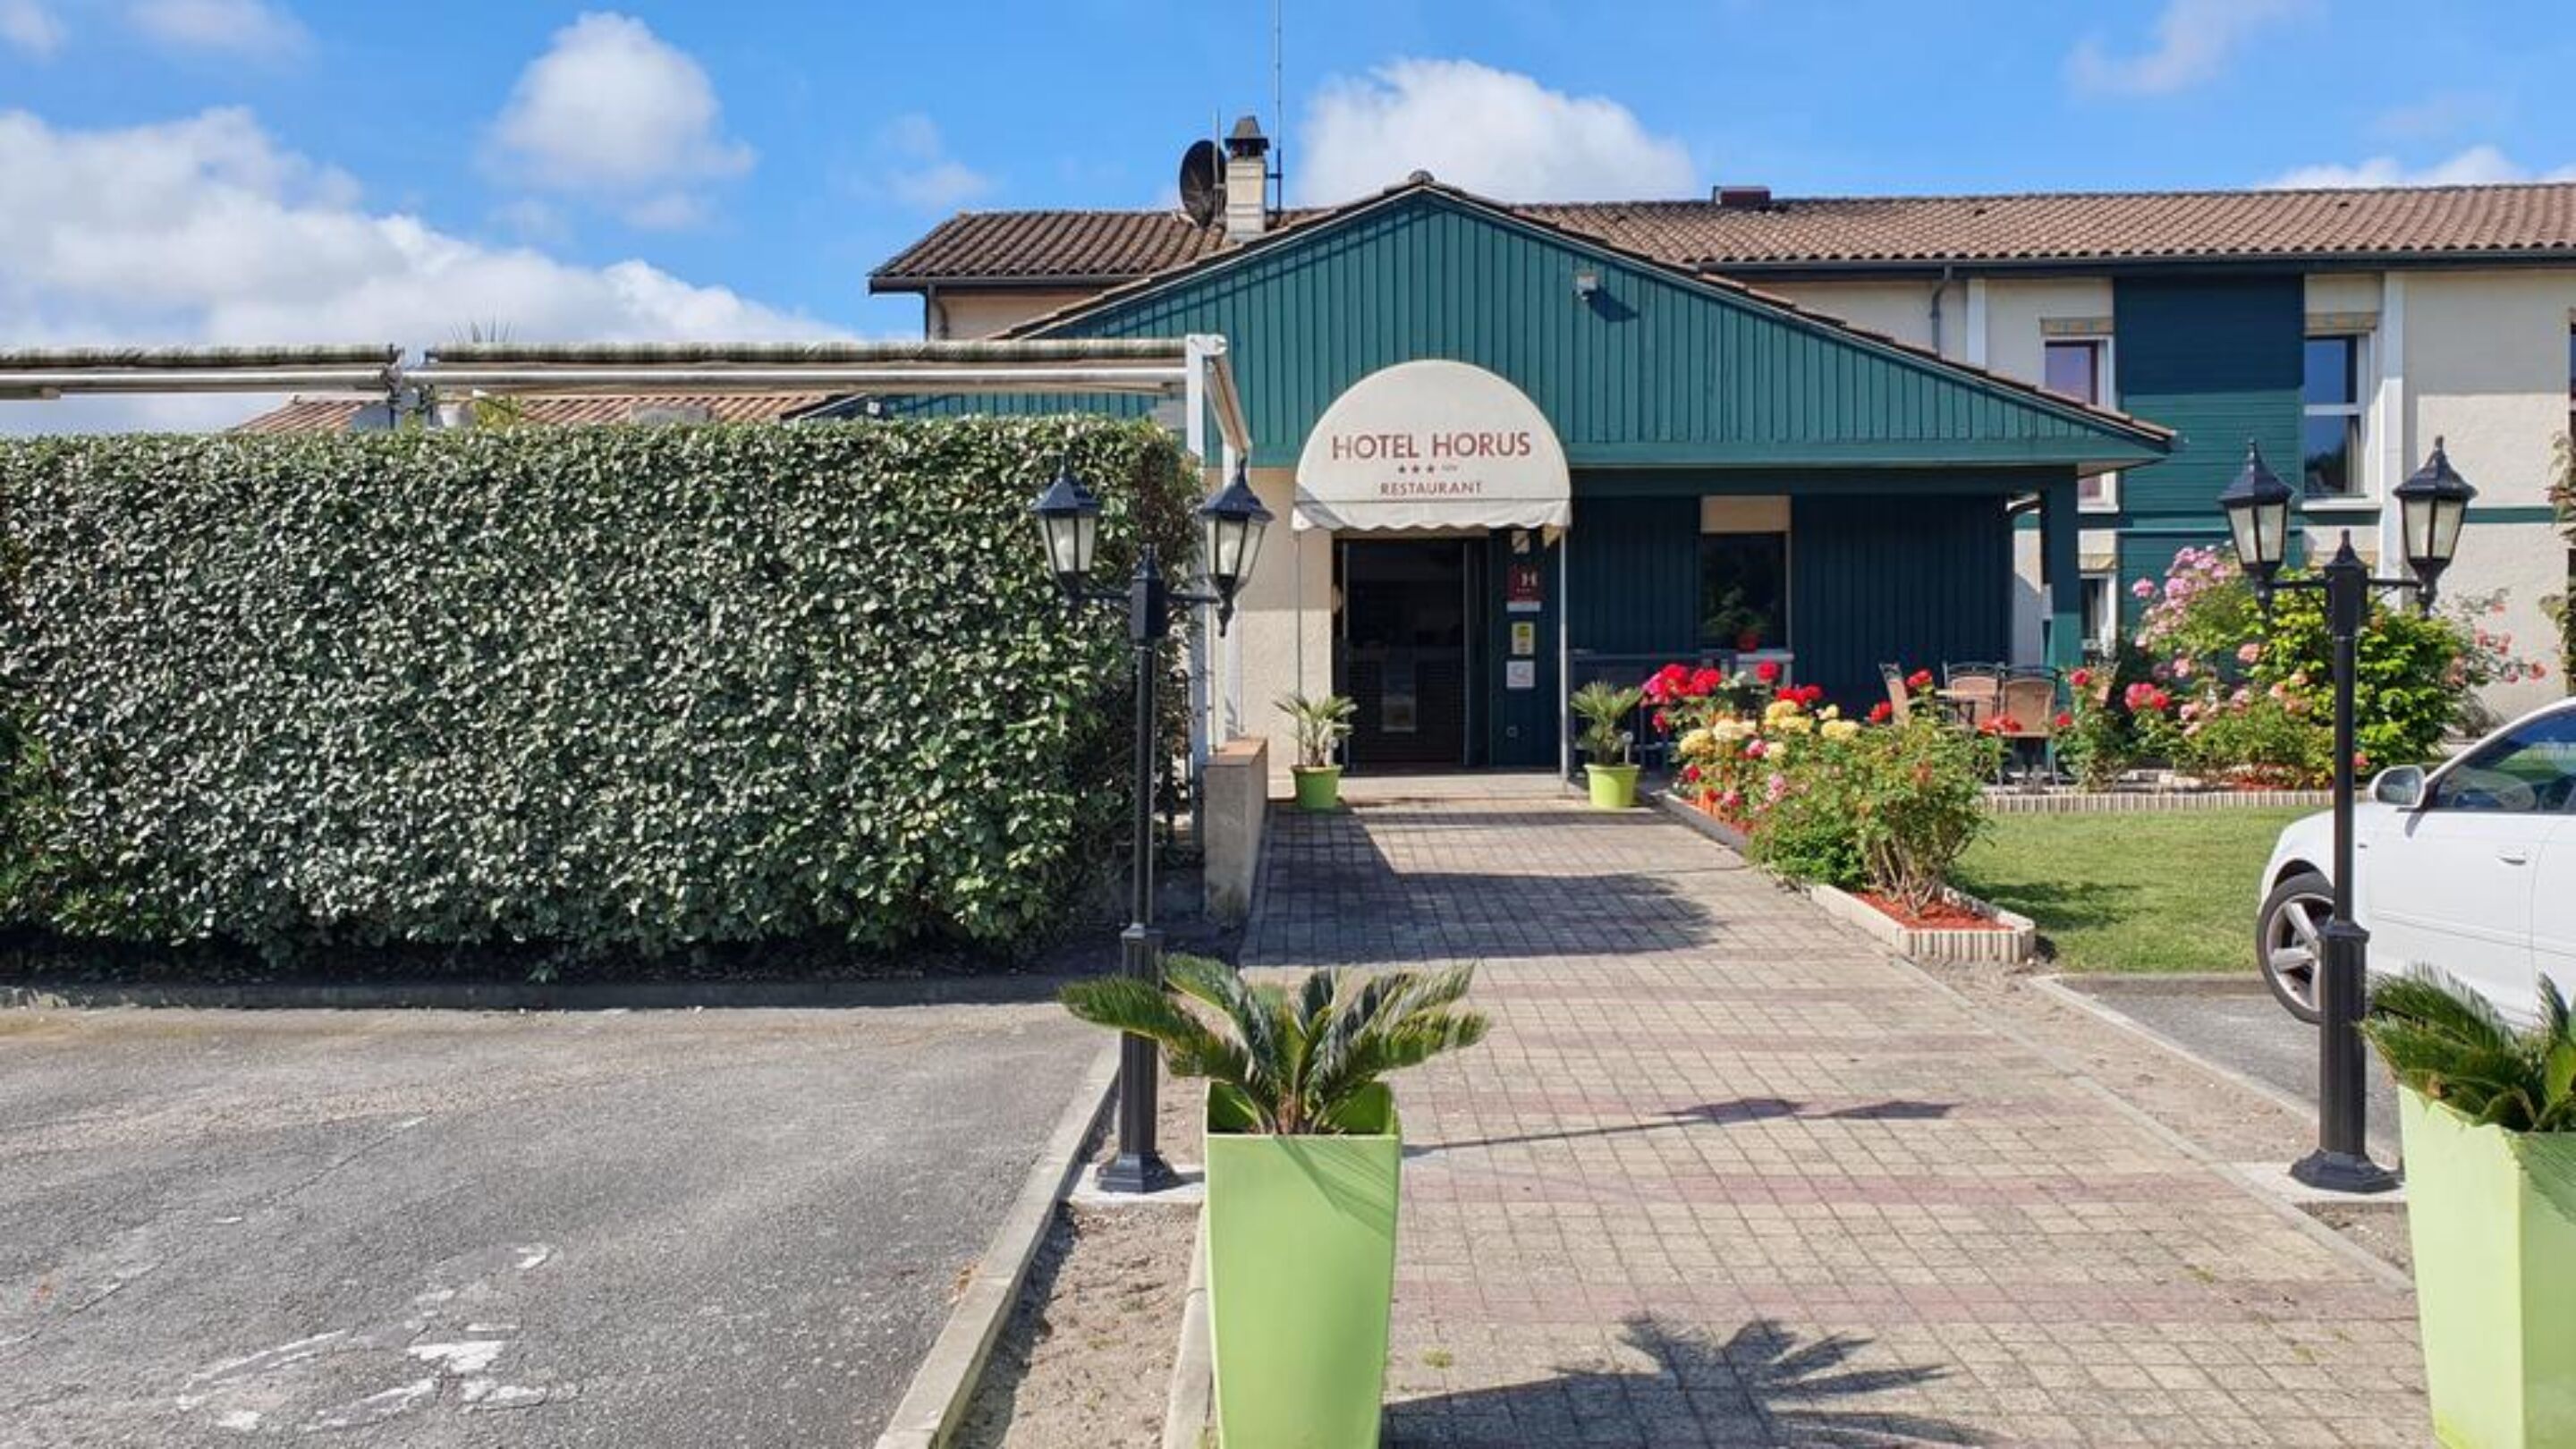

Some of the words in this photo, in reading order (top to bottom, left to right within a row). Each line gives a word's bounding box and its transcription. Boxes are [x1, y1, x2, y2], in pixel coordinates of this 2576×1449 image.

[1332, 434, 1420, 460] HOTEL
[1432, 432, 1531, 458] HORUS
[1380, 482, 1483, 496] RESTAURANT
